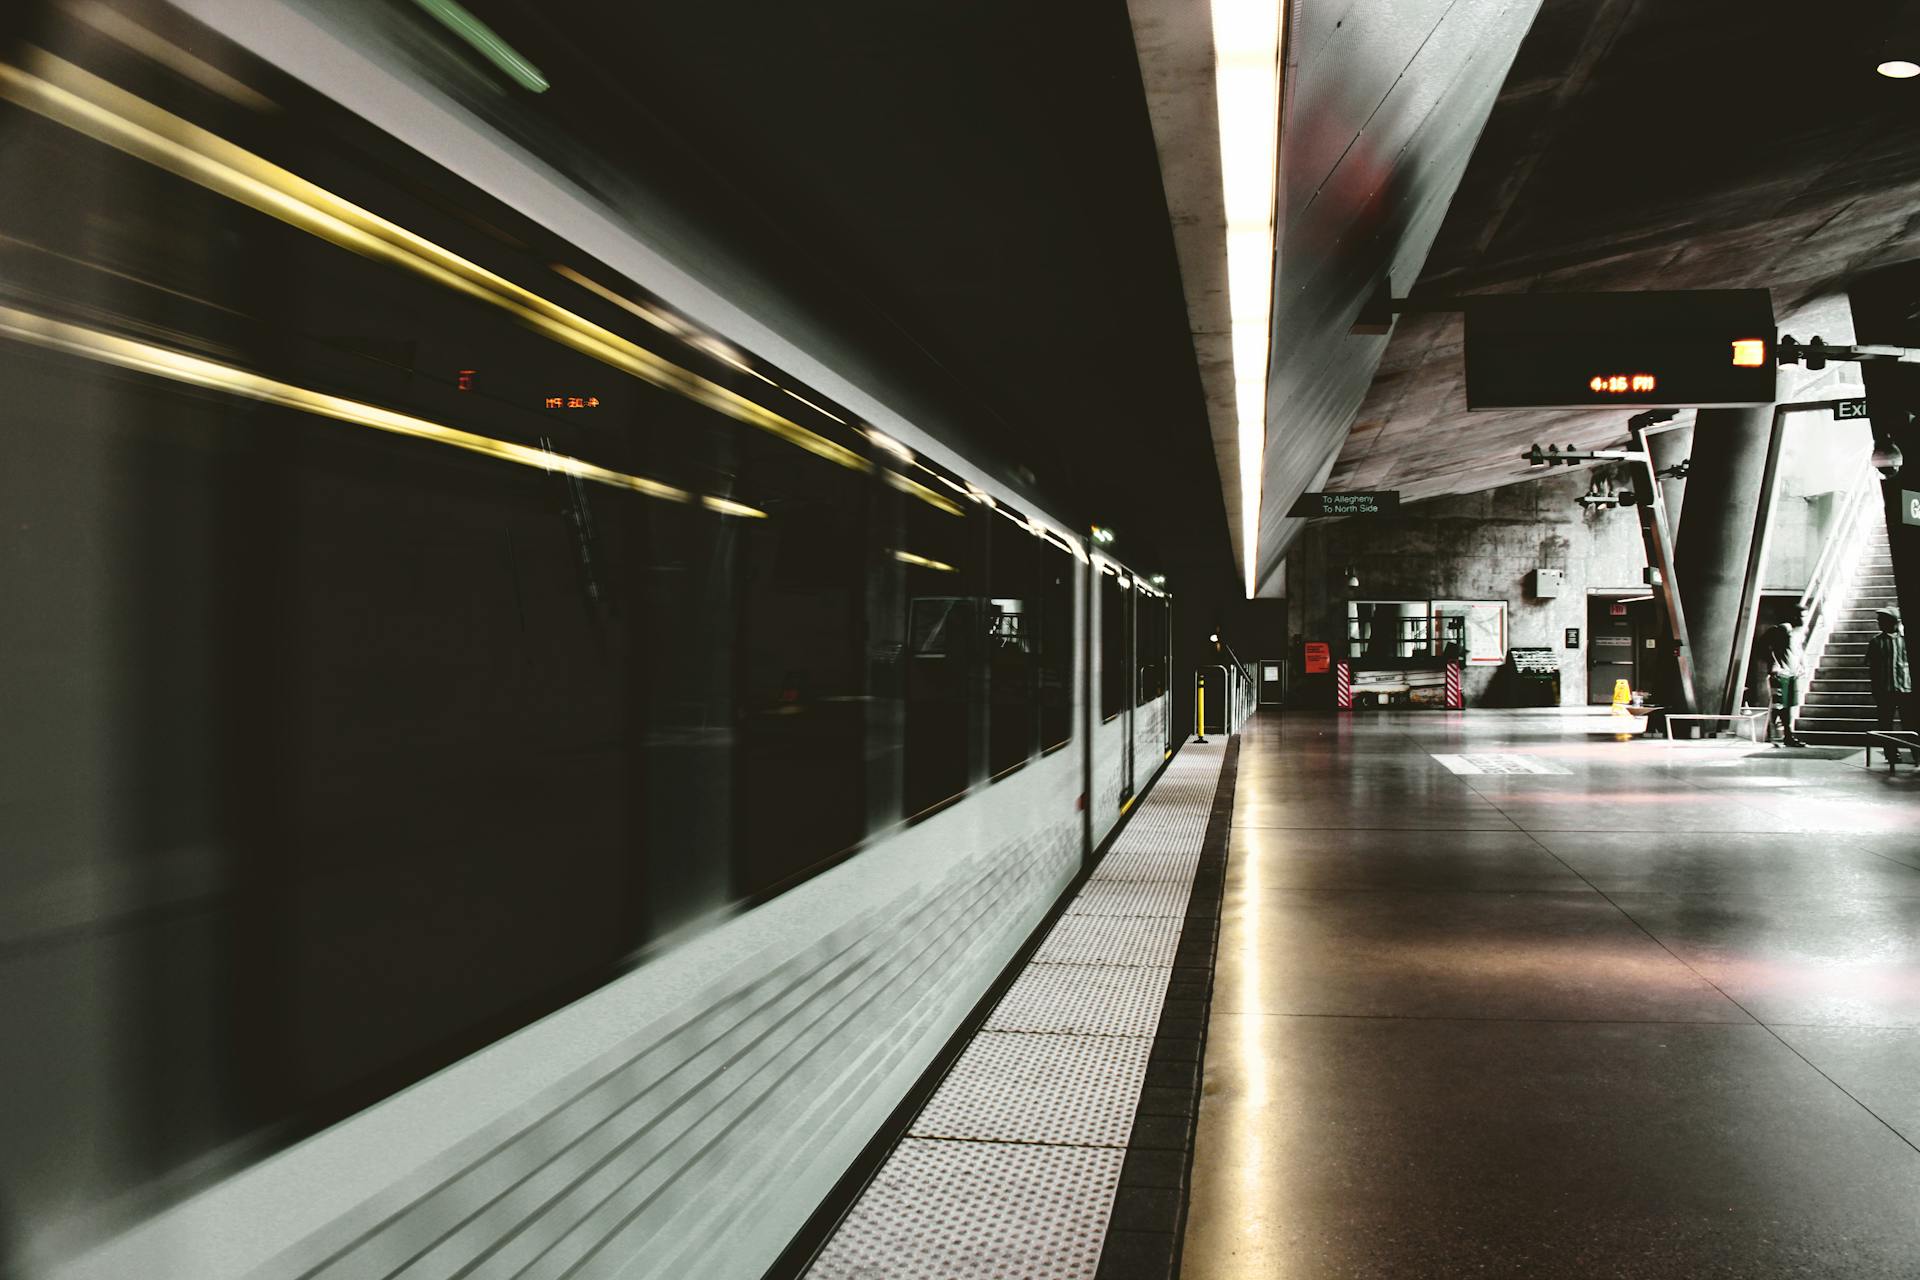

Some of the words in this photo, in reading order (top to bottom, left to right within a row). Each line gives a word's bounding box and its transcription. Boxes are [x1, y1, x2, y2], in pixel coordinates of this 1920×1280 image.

[1633, 376, 1655, 392] PM
[1839, 401, 1867, 417] Exi
[1334, 496, 1374, 504] Allegheny
[1359, 504, 1378, 512] Side
